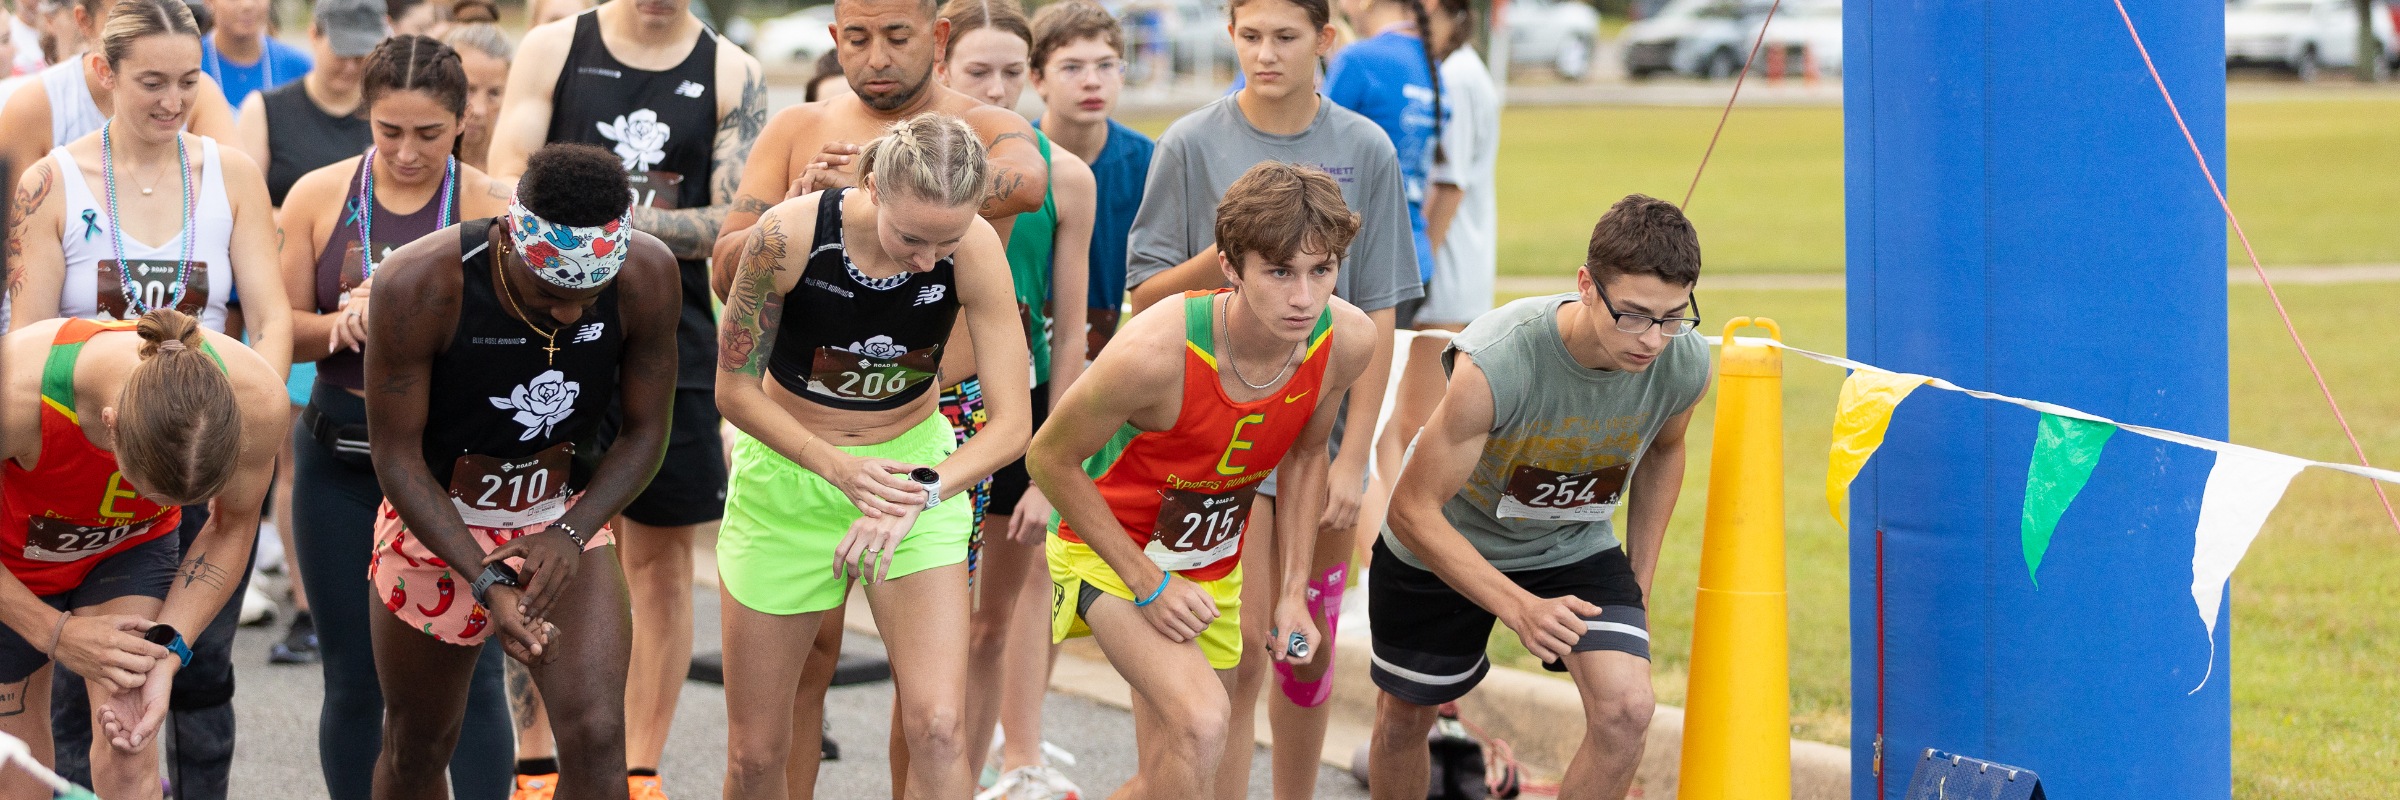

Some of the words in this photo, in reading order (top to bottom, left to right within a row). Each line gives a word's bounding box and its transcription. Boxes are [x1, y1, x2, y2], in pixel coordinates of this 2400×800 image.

[837, 371, 906, 397] 206
[1216, 413, 1265, 476] E
[516, 461, 533, 469] ROAD
[476, 468, 549, 507] 210
[1166, 473, 1222, 490] EXPRESS
[1528, 477, 1599, 506] 254
[56, 524, 131, 551] 220
[1174, 504, 1240, 548] 215
